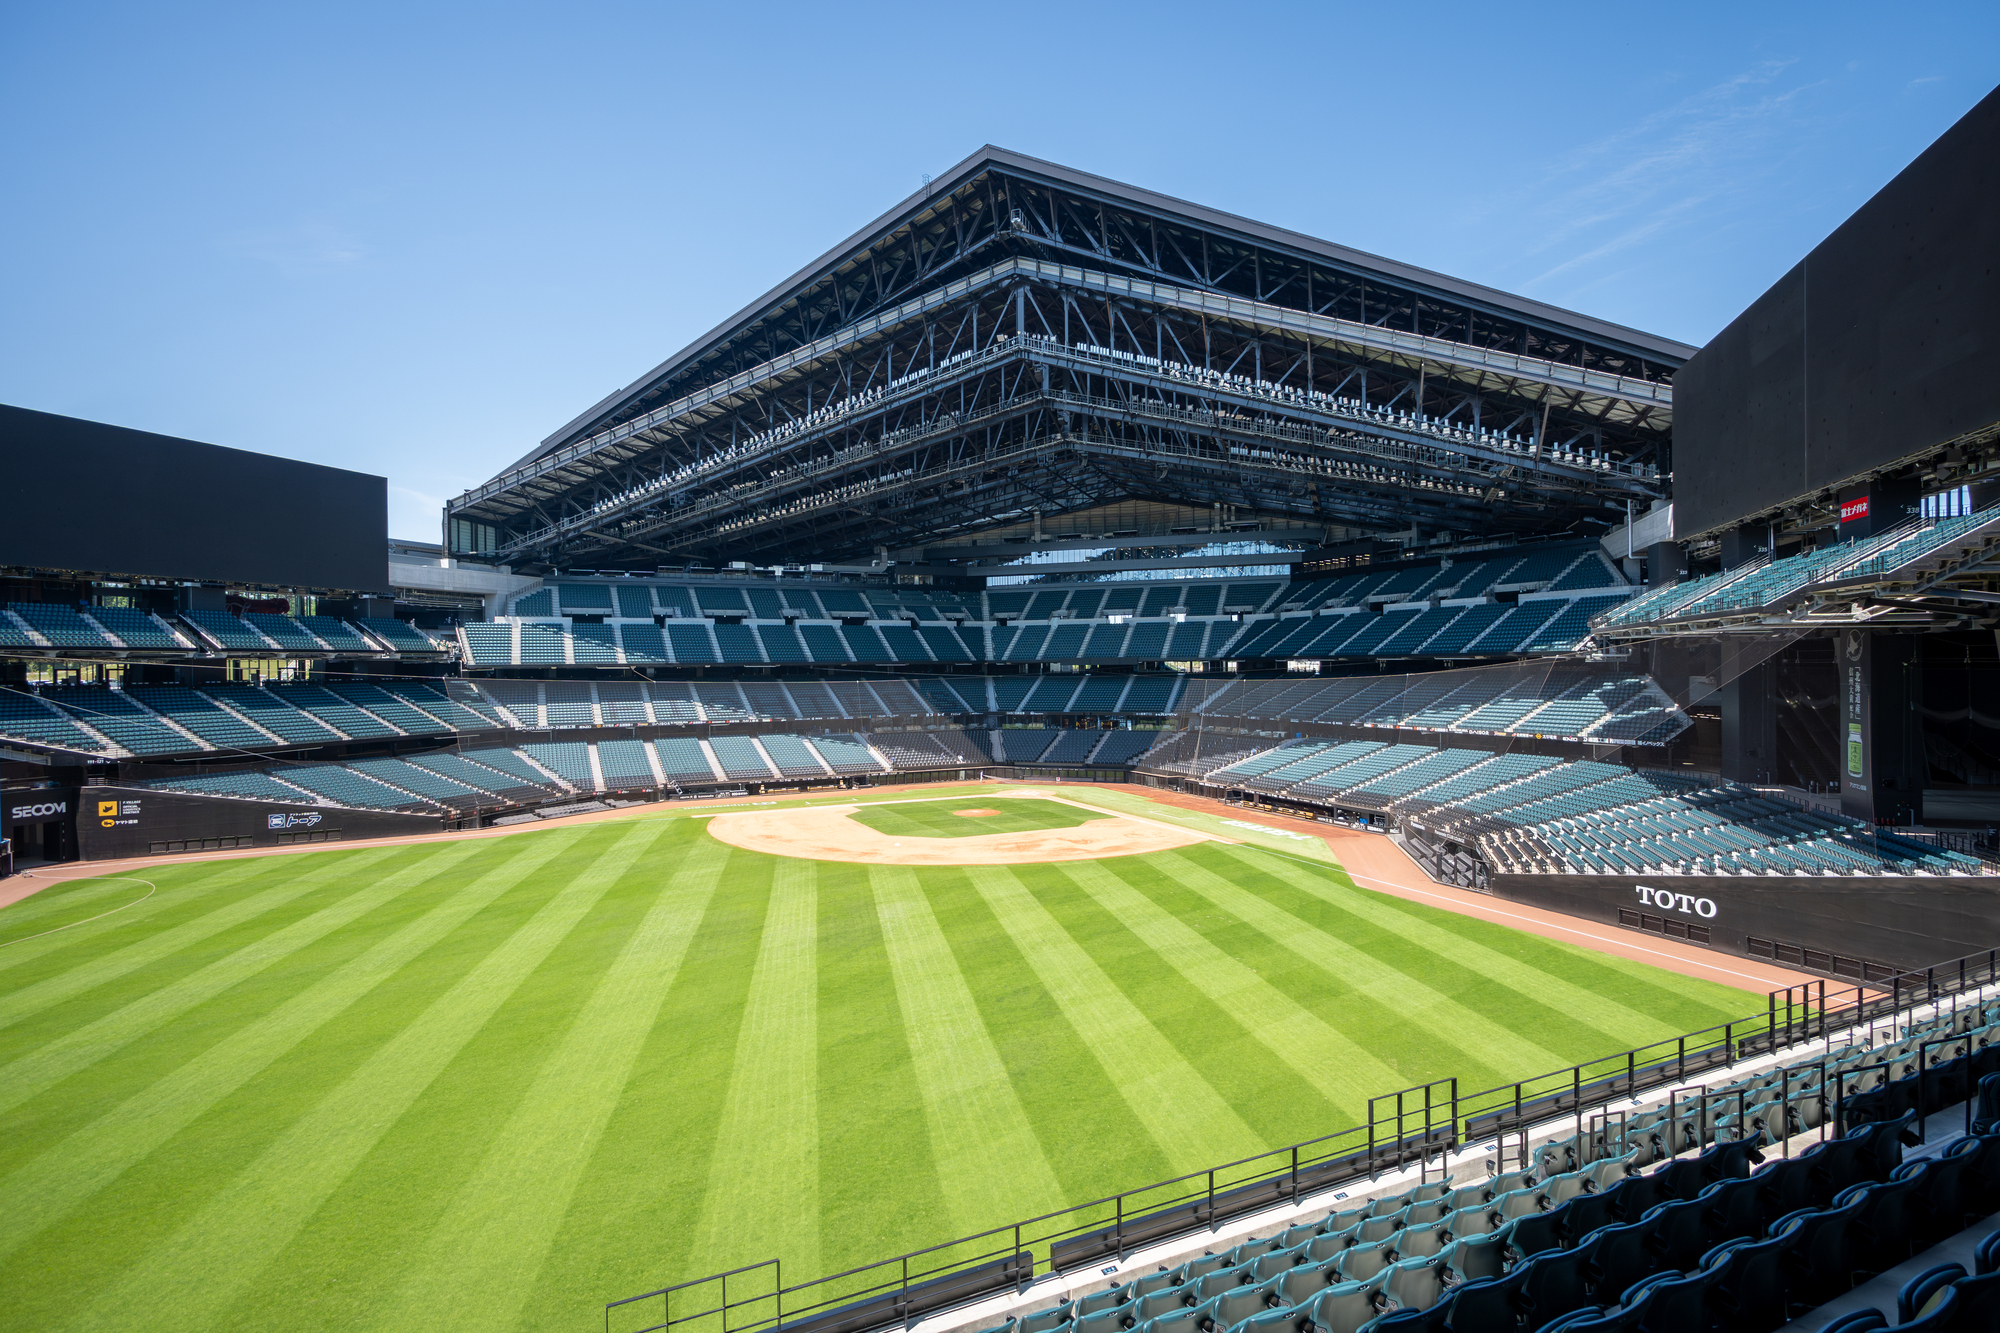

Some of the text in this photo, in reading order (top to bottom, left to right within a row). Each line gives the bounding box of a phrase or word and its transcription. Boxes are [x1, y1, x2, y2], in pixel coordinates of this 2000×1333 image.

[1841, 502, 1867, 518] 富士メガネ
[12, 802, 66, 818] SECOM
[286, 815, 322, 828] トーア
[1635, 885, 1717, 918] TOTO
